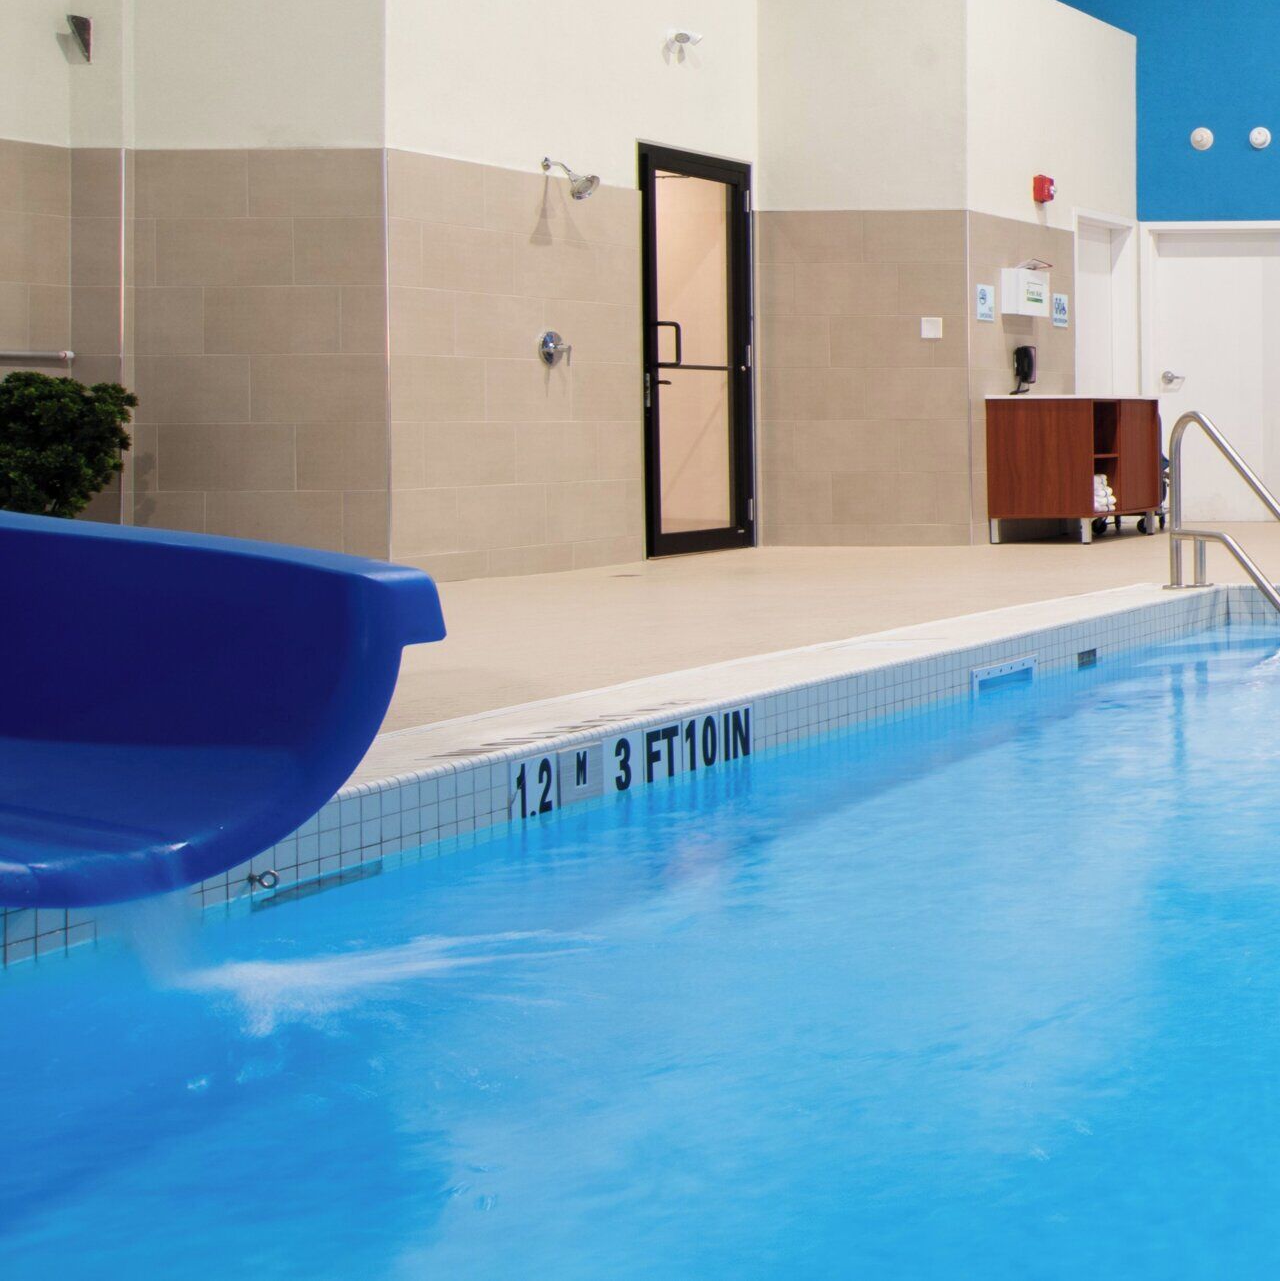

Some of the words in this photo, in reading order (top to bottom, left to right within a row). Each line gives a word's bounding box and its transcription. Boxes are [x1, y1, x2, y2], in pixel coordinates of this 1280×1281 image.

[516, 757, 553, 819] 1.2
[576, 750, 587, 786] M
[614, 737, 632, 791] 3
[645, 724, 679, 784] FT
[684, 715, 717, 772] 10
[723, 707, 750, 762] IN
